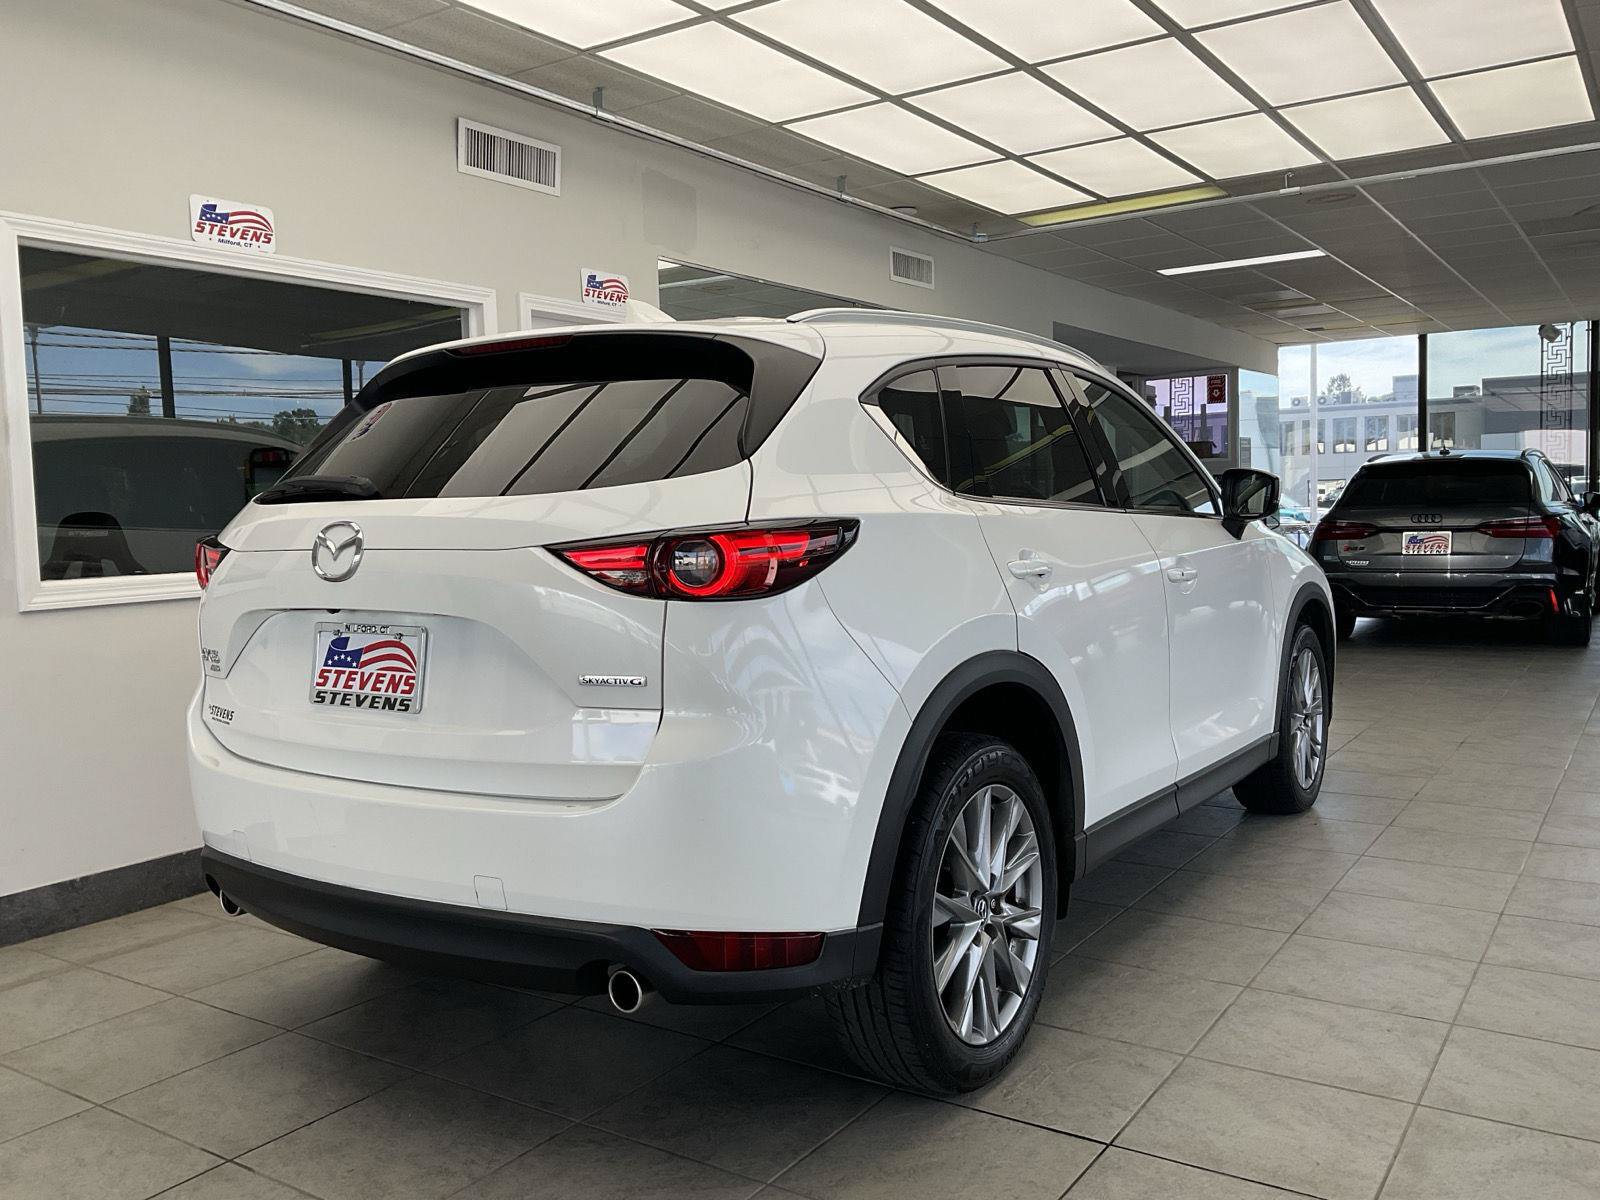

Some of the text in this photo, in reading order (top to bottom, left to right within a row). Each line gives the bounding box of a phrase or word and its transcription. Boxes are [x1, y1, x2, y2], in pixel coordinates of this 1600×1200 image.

[194, 221, 274, 244] STEVENS
[584, 288, 629, 303] STEVENS
[1404, 543, 1449, 551] STEVENS
[315, 668, 416, 695] STEVENS
[582, 677, 629, 685] SKYACTIV
[313, 690, 412, 712] STEVENS
[210, 704, 235, 721] STEVENS
